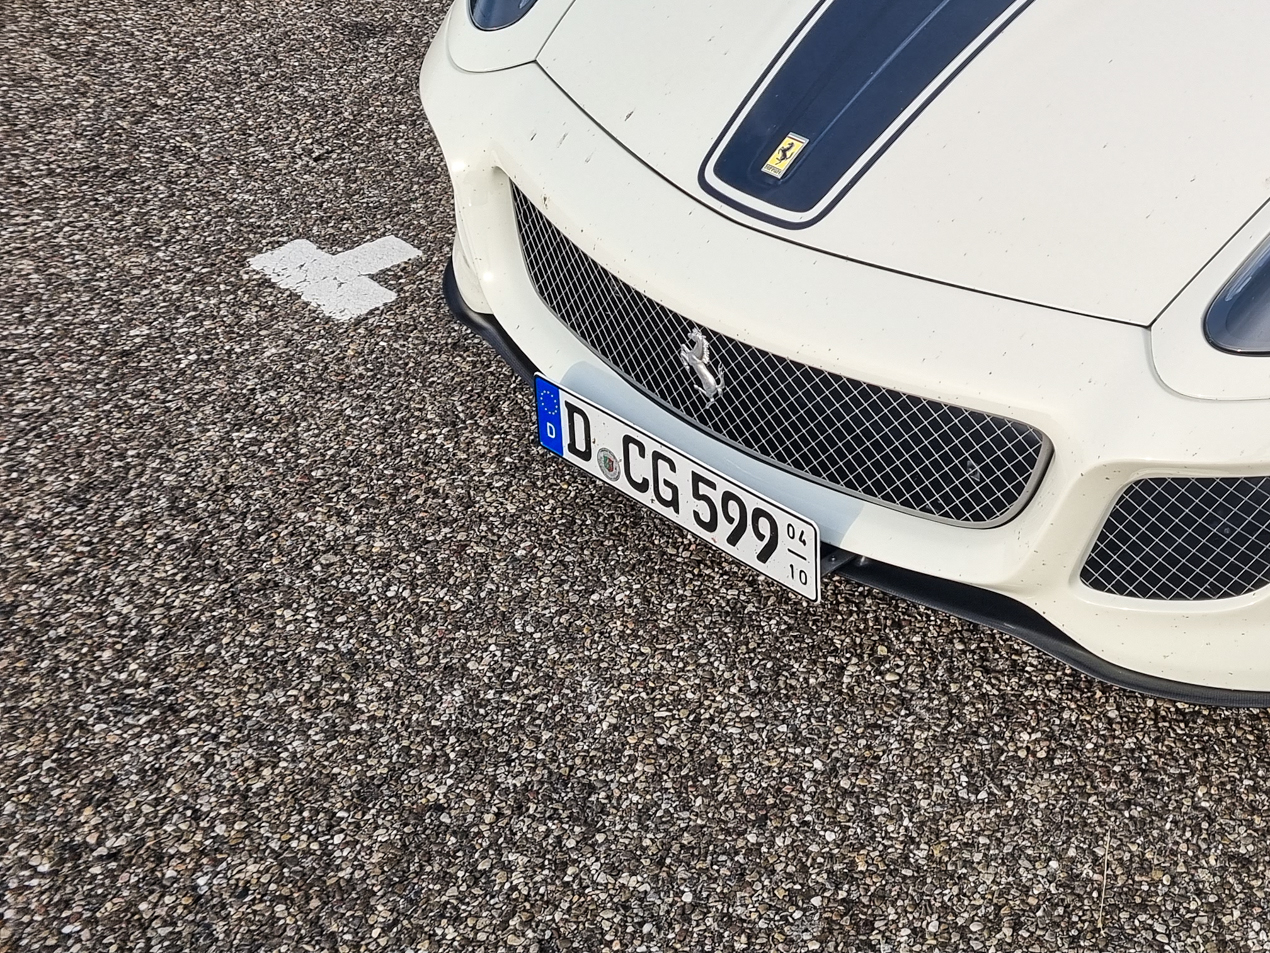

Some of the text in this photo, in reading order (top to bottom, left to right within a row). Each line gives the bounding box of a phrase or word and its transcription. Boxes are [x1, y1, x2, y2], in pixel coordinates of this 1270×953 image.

[546, 422, 556, 439] D
[564, 400, 779, 564] D CG 599
[786, 523, 807, 546] 04
[789, 563, 808, 586] 10
